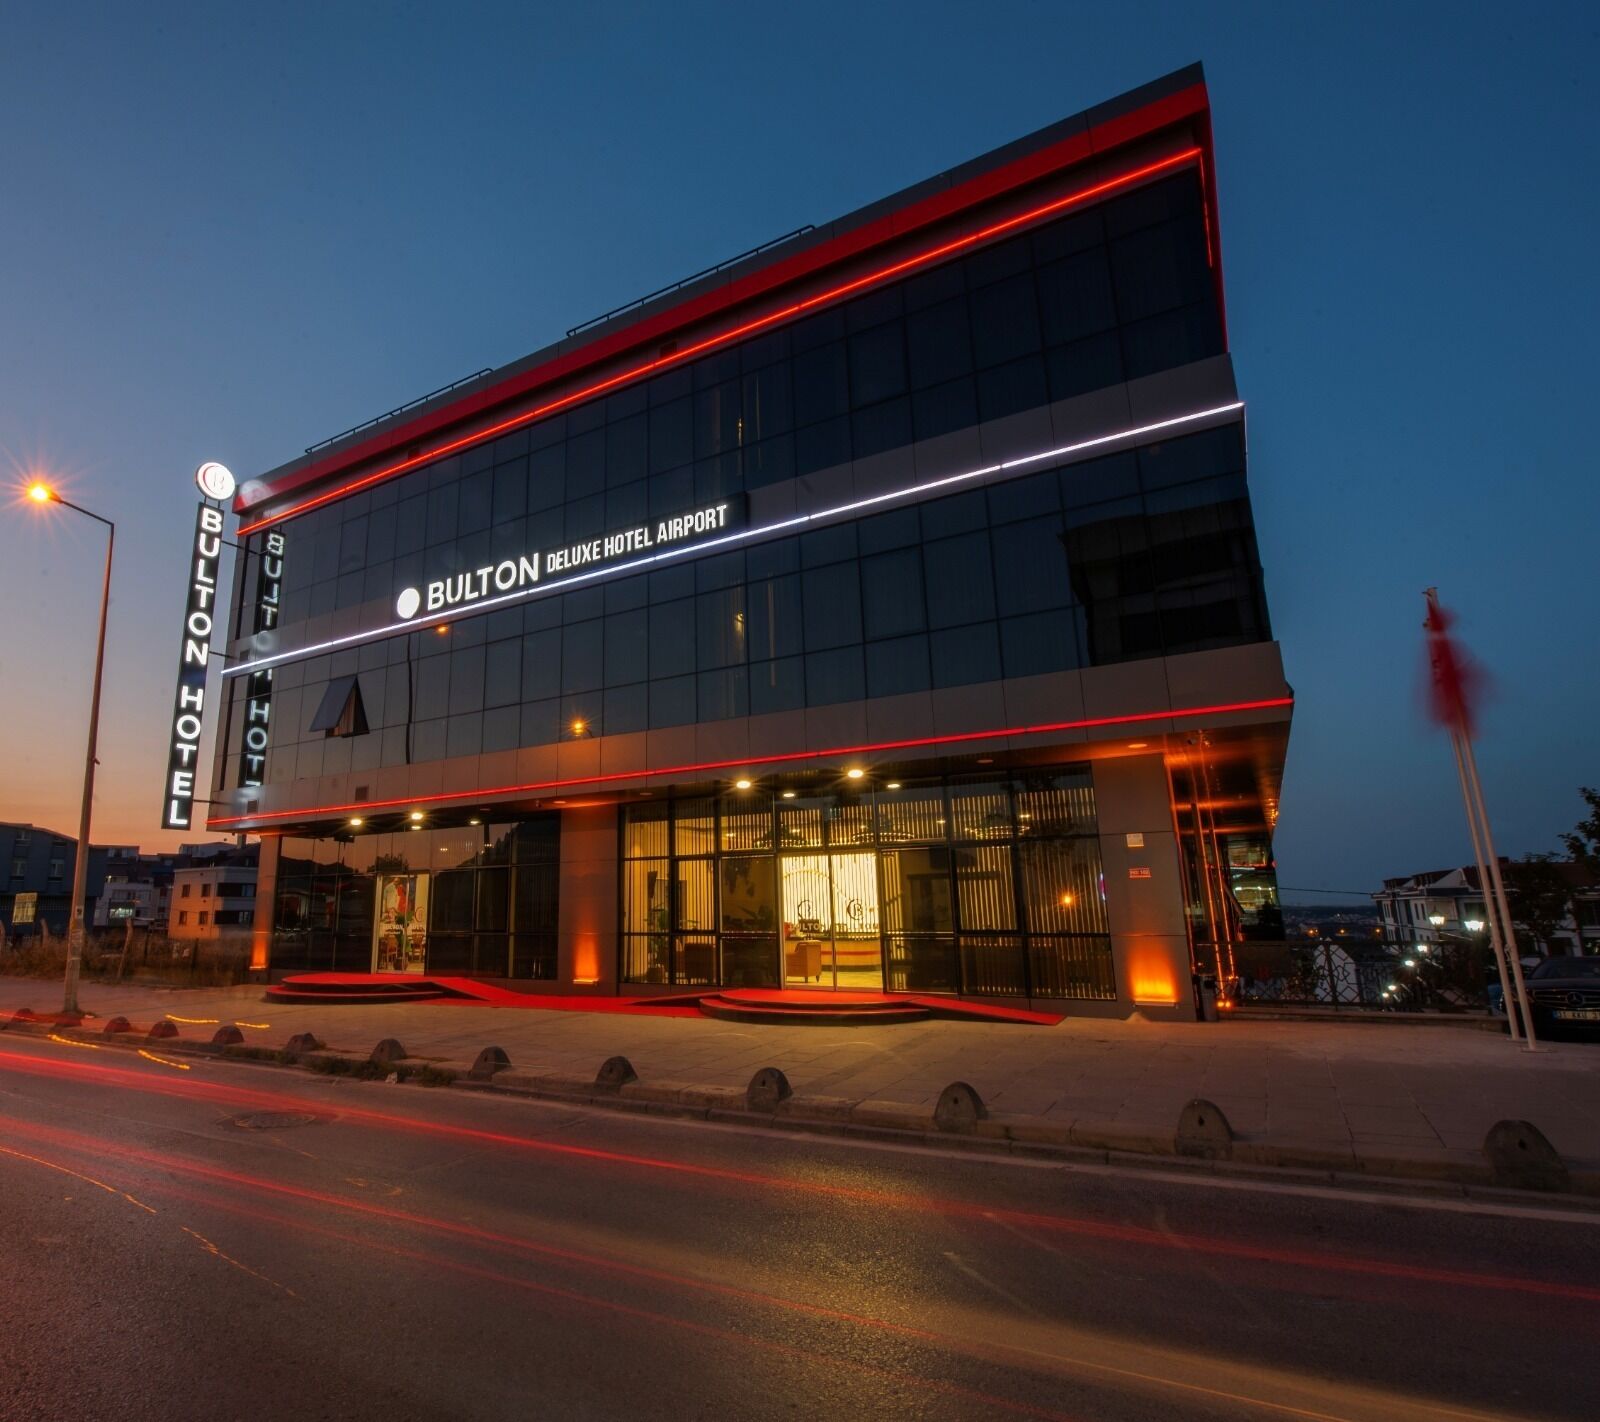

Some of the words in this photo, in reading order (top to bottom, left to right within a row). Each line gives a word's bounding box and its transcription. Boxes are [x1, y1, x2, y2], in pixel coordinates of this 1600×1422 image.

[185, 507, 223, 666] BULTON
[427, 552, 539, 611] BULTON
[546, 540, 602, 574] DELUXE
[604, 527, 653, 557] HOTEL
[656, 504, 728, 543] AIRPORT
[169, 685, 204, 826] HOTEL
